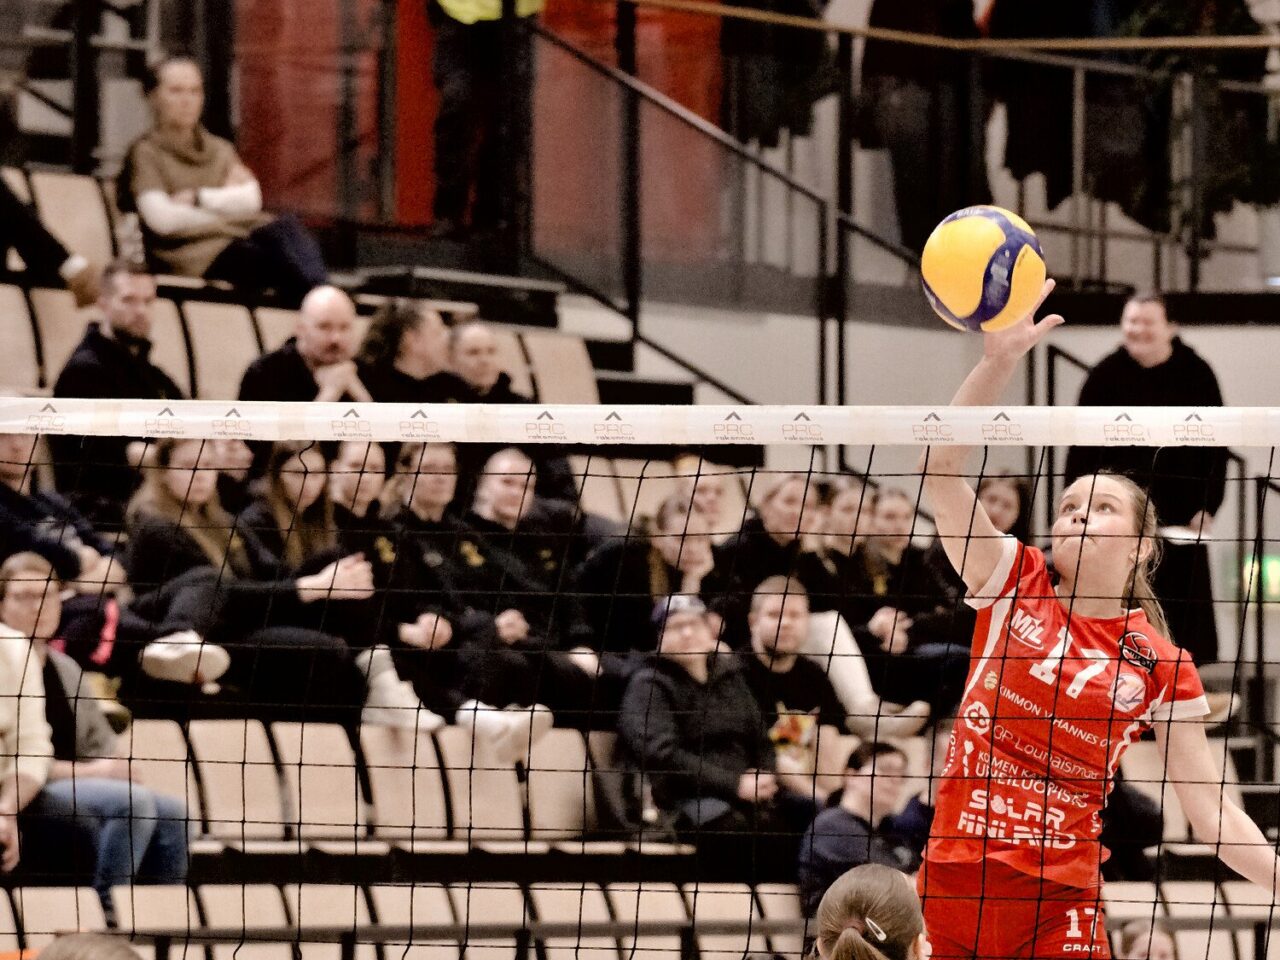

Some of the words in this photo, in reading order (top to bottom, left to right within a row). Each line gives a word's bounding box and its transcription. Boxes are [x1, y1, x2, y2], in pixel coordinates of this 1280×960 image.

[1029, 626, 1110, 699] 17
[993, 724, 1014, 743] OP
[1044, 710, 1099, 745] VHANNES
[957, 811, 1077, 850] FINLAND
[1066, 907, 1099, 940] 17
[1062, 943, 1101, 954] CRAFT
